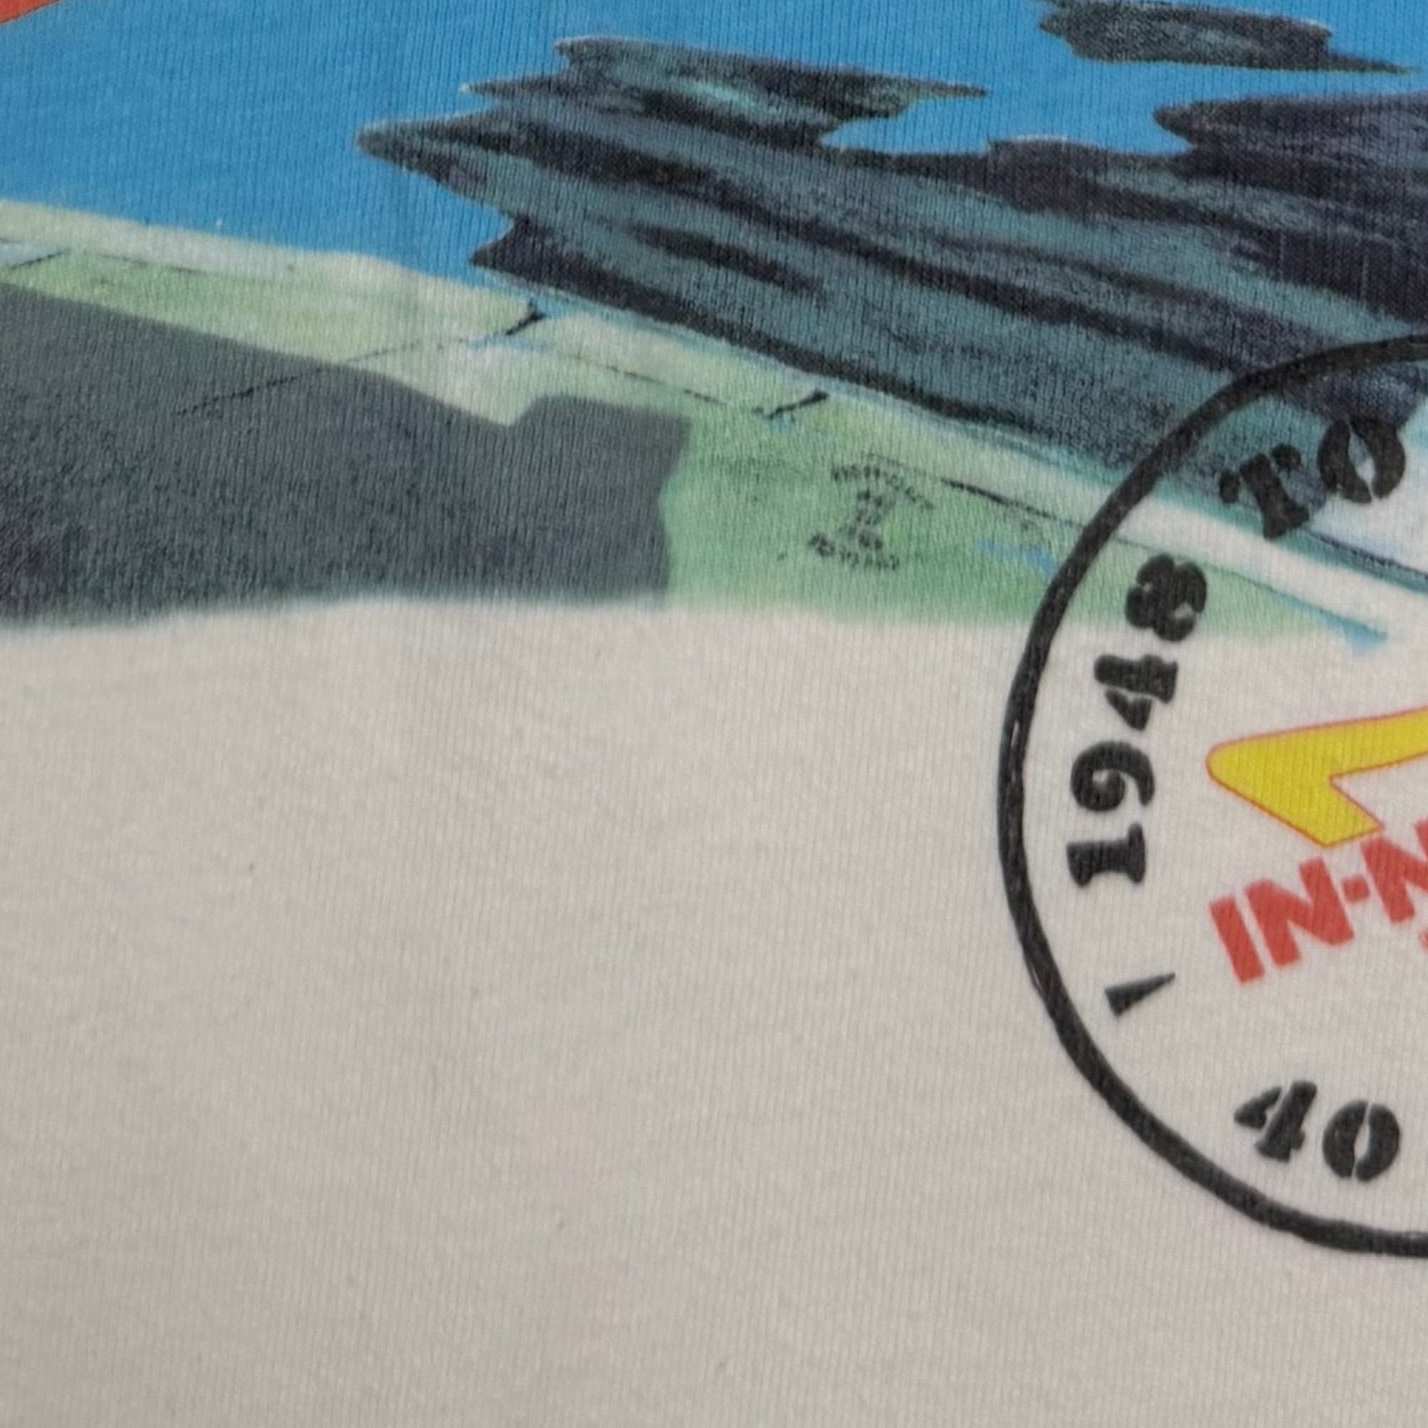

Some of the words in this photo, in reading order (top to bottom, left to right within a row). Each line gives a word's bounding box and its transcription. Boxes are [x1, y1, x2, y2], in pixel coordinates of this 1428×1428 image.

[1066, 553, 1209, 888] 1948
[1218, 415, 1407, 541] TO
[1233, 1079, 1402, 1183] 40
